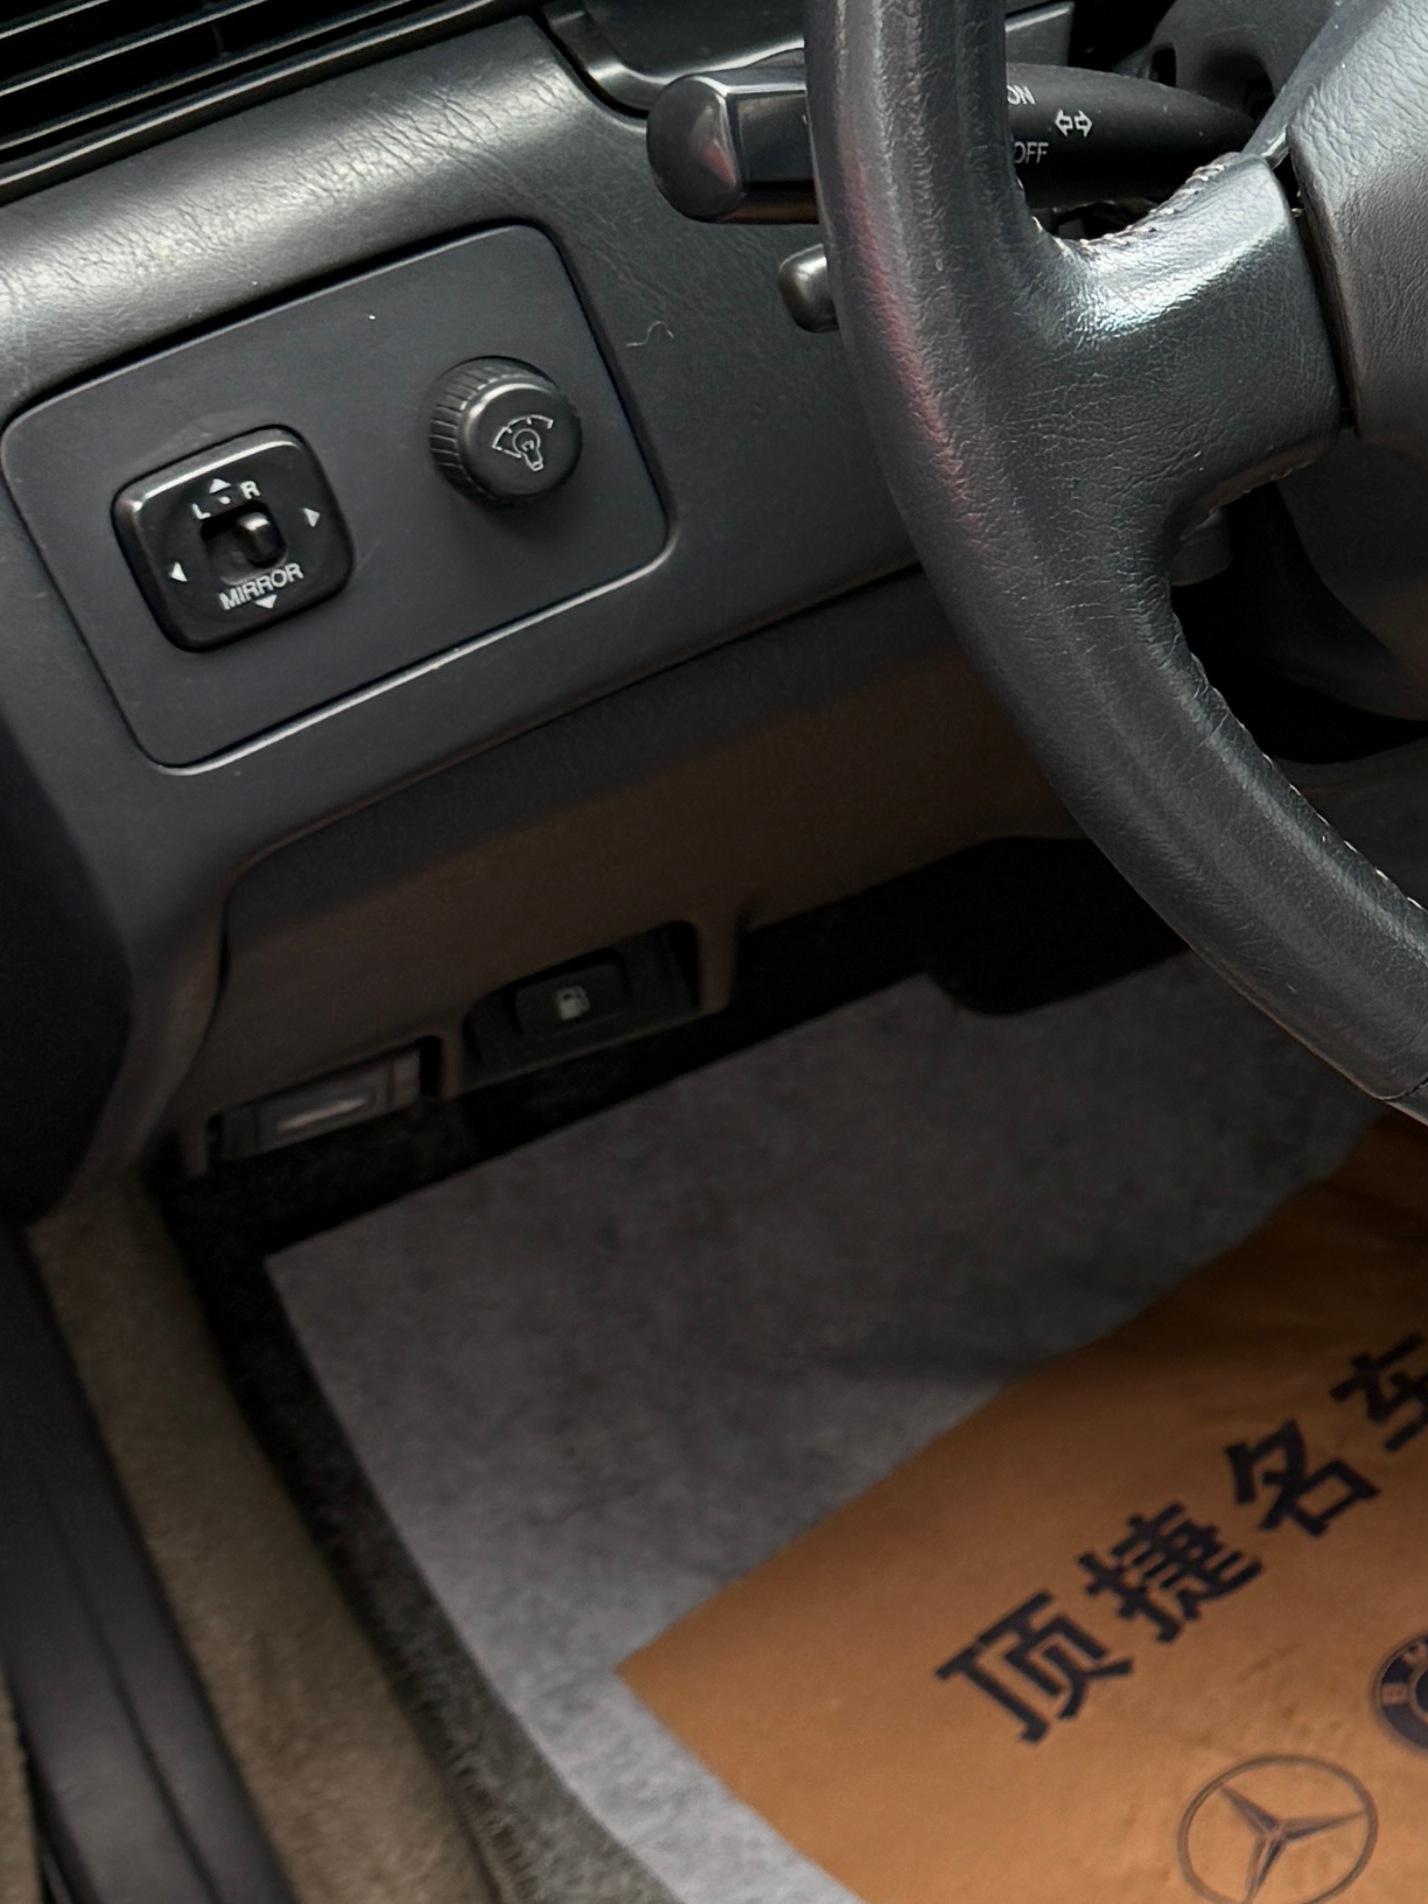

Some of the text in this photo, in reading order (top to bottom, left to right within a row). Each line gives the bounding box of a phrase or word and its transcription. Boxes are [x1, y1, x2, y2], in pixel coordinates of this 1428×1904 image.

[191, 480, 261, 520] L R
[218, 562, 305, 611] MIRROR
